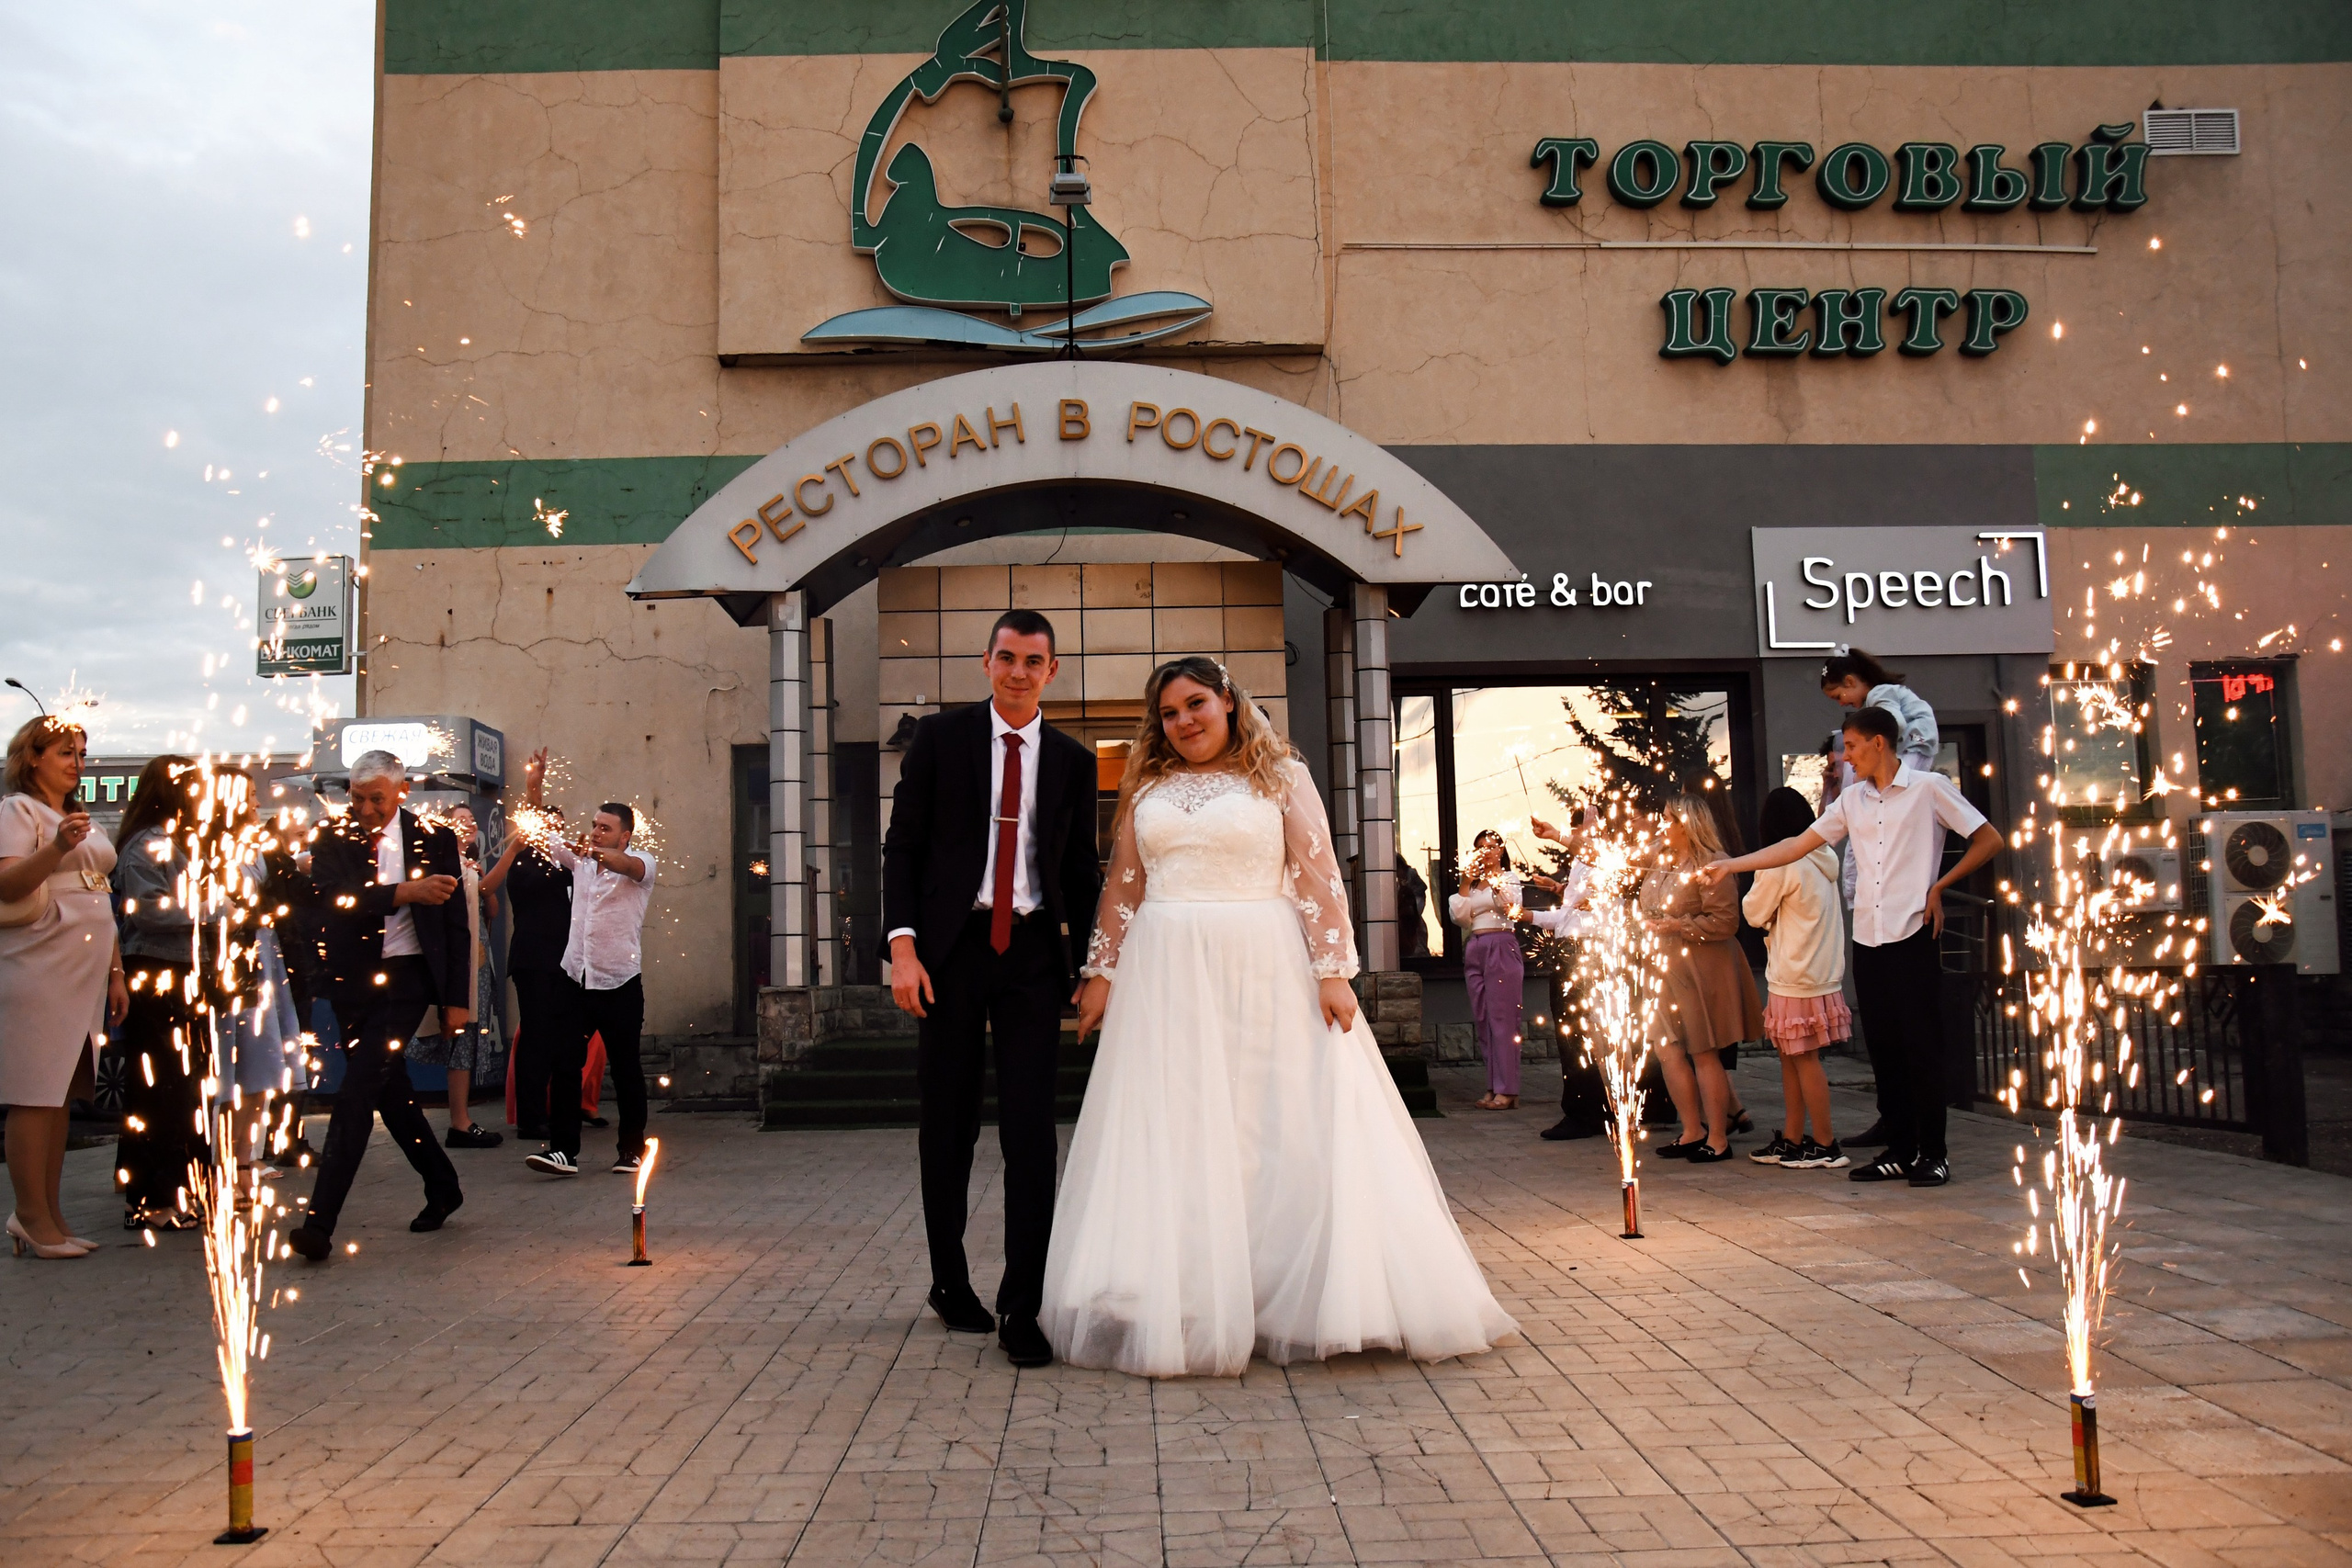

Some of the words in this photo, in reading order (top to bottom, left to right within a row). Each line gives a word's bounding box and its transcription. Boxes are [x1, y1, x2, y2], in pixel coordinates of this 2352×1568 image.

[1530, 120, 2152, 213] ТОРГОВЫЙ
[1657, 285, 2029, 367] ЦЕНТР
[727, 401, 1025, 566] РЕСТОРАН
[1058, 398, 1091, 441] В
[1126, 400, 1425, 558] РОСТОШАХ
[1550, 572, 1577, 607] &
[1591, 571, 1653, 606] bar
[1803, 554, 2012, 625] Speech
[480, 752, 496, 773] ВОДА
